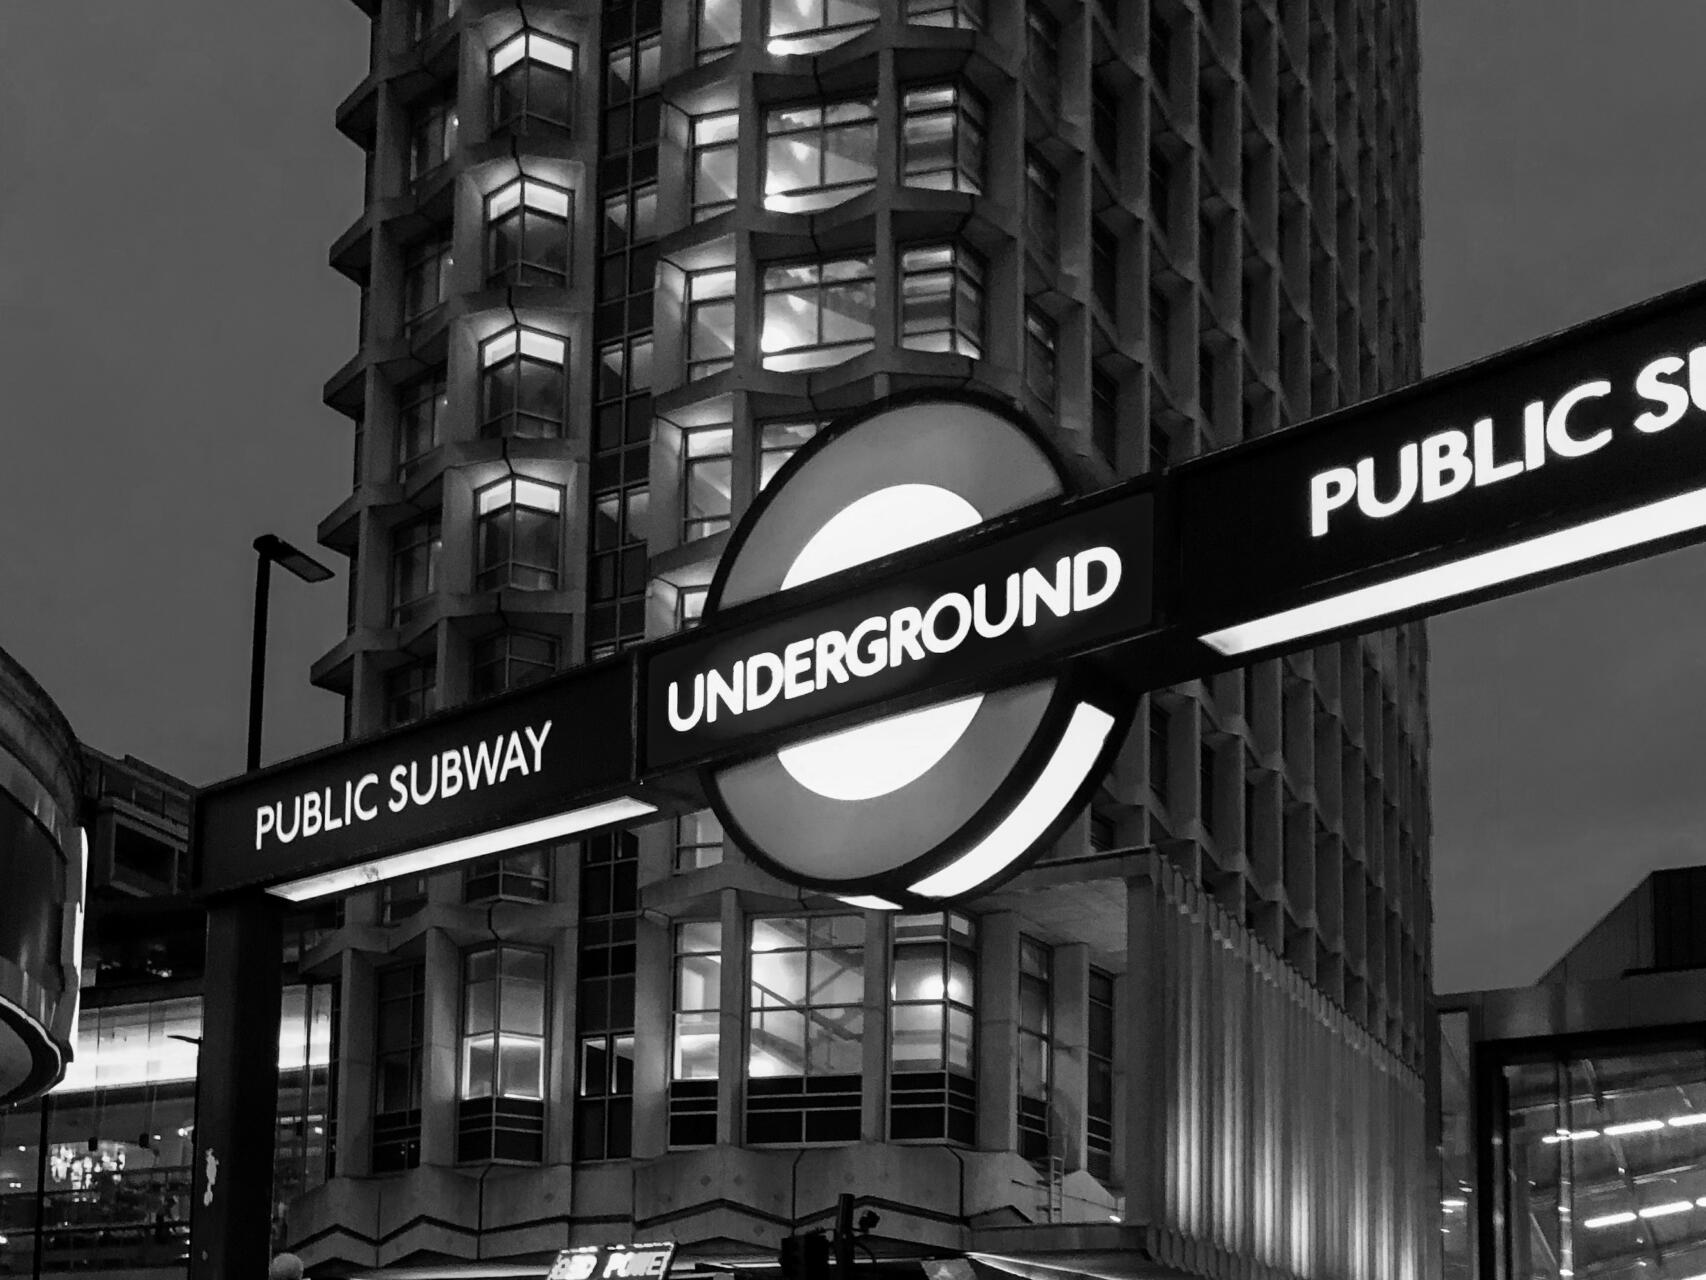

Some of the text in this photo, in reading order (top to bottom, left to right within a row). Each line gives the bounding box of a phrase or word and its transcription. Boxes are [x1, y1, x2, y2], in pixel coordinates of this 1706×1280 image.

[1310, 346, 1706, 538] PUBLIC S
[667, 546, 1122, 732] UNDERGROUND
[255, 719, 552, 851] PUBLIC SUBWAY
